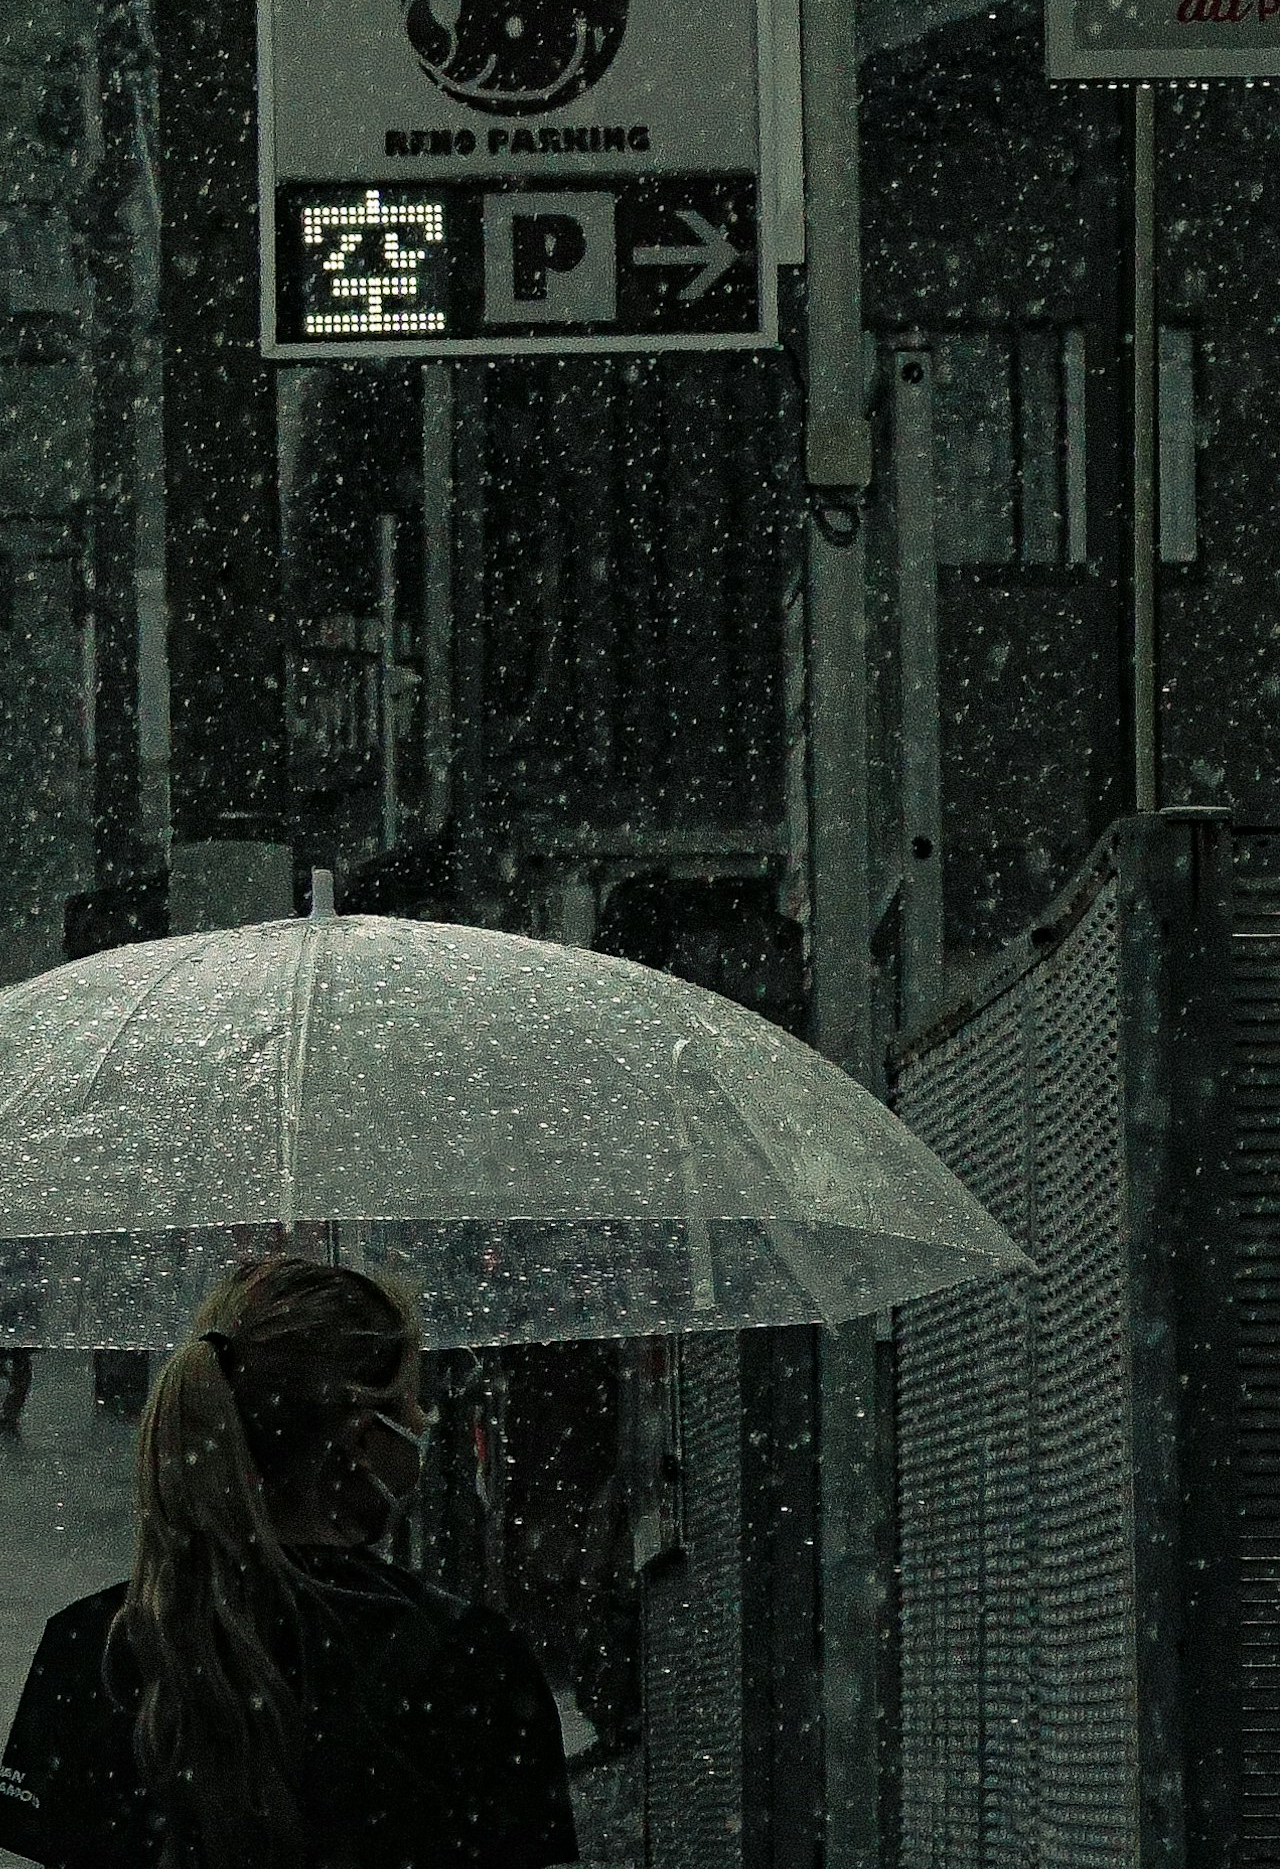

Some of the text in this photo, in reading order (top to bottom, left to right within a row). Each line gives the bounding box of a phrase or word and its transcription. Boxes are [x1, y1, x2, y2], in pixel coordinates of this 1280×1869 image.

[385, 126, 651, 156] RENO PARKING
[302, 189, 445, 333] 空
[513, 213, 586, 301] P
